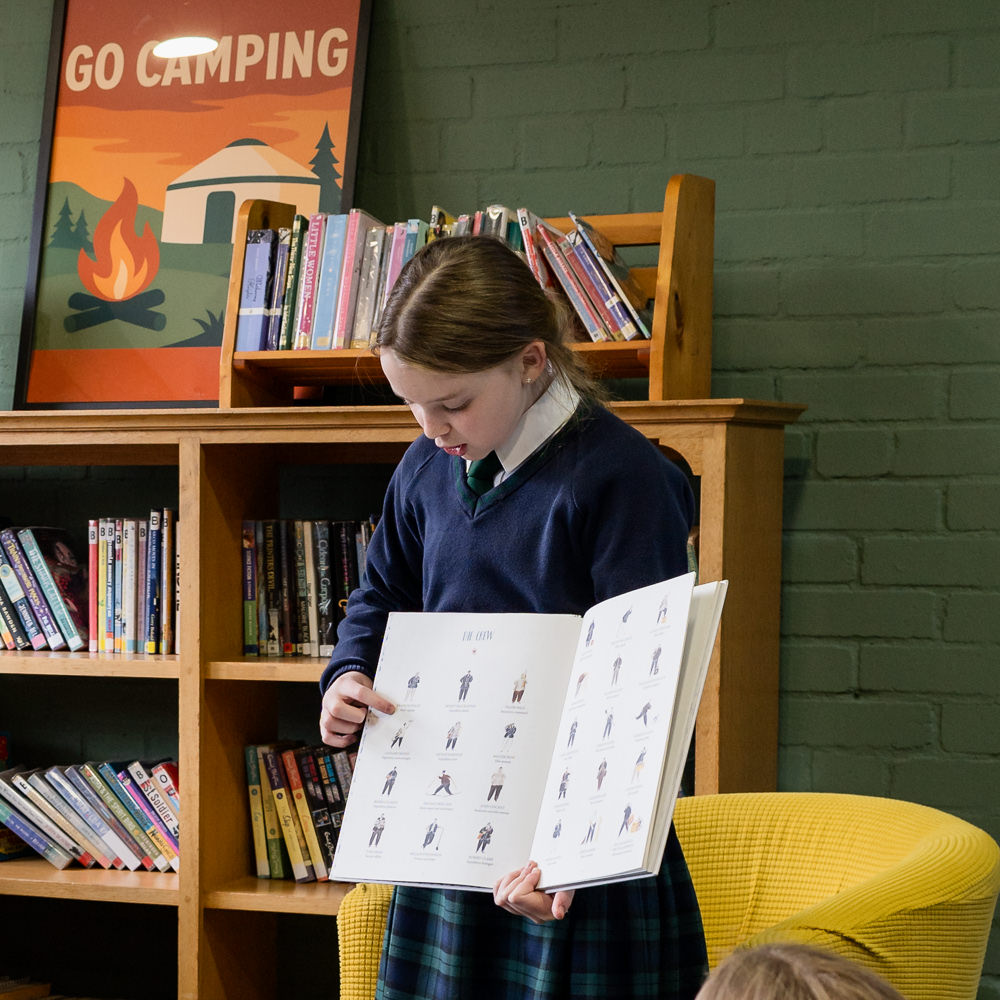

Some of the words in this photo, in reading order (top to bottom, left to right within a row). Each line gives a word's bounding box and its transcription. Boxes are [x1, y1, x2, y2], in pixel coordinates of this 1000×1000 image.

[66, 42, 124, 92] GO
[136, 28, 349, 87] CAMPING
[521, 217, 527, 226] B
[308, 222, 319, 257] LITTLE
[303, 259, 314, 298] WOMEN
[140, 528, 145, 537] B
[27, 548, 40, 564] THE
[1, 606, 17, 633] BAWDEN
[265, 753, 276, 769] Enid
[136, 771, 143, 779] B
[269, 768, 281, 786] Blyton
[110, 801, 126, 818] SPIRIT
[150, 793, 174, 824] Soldier
